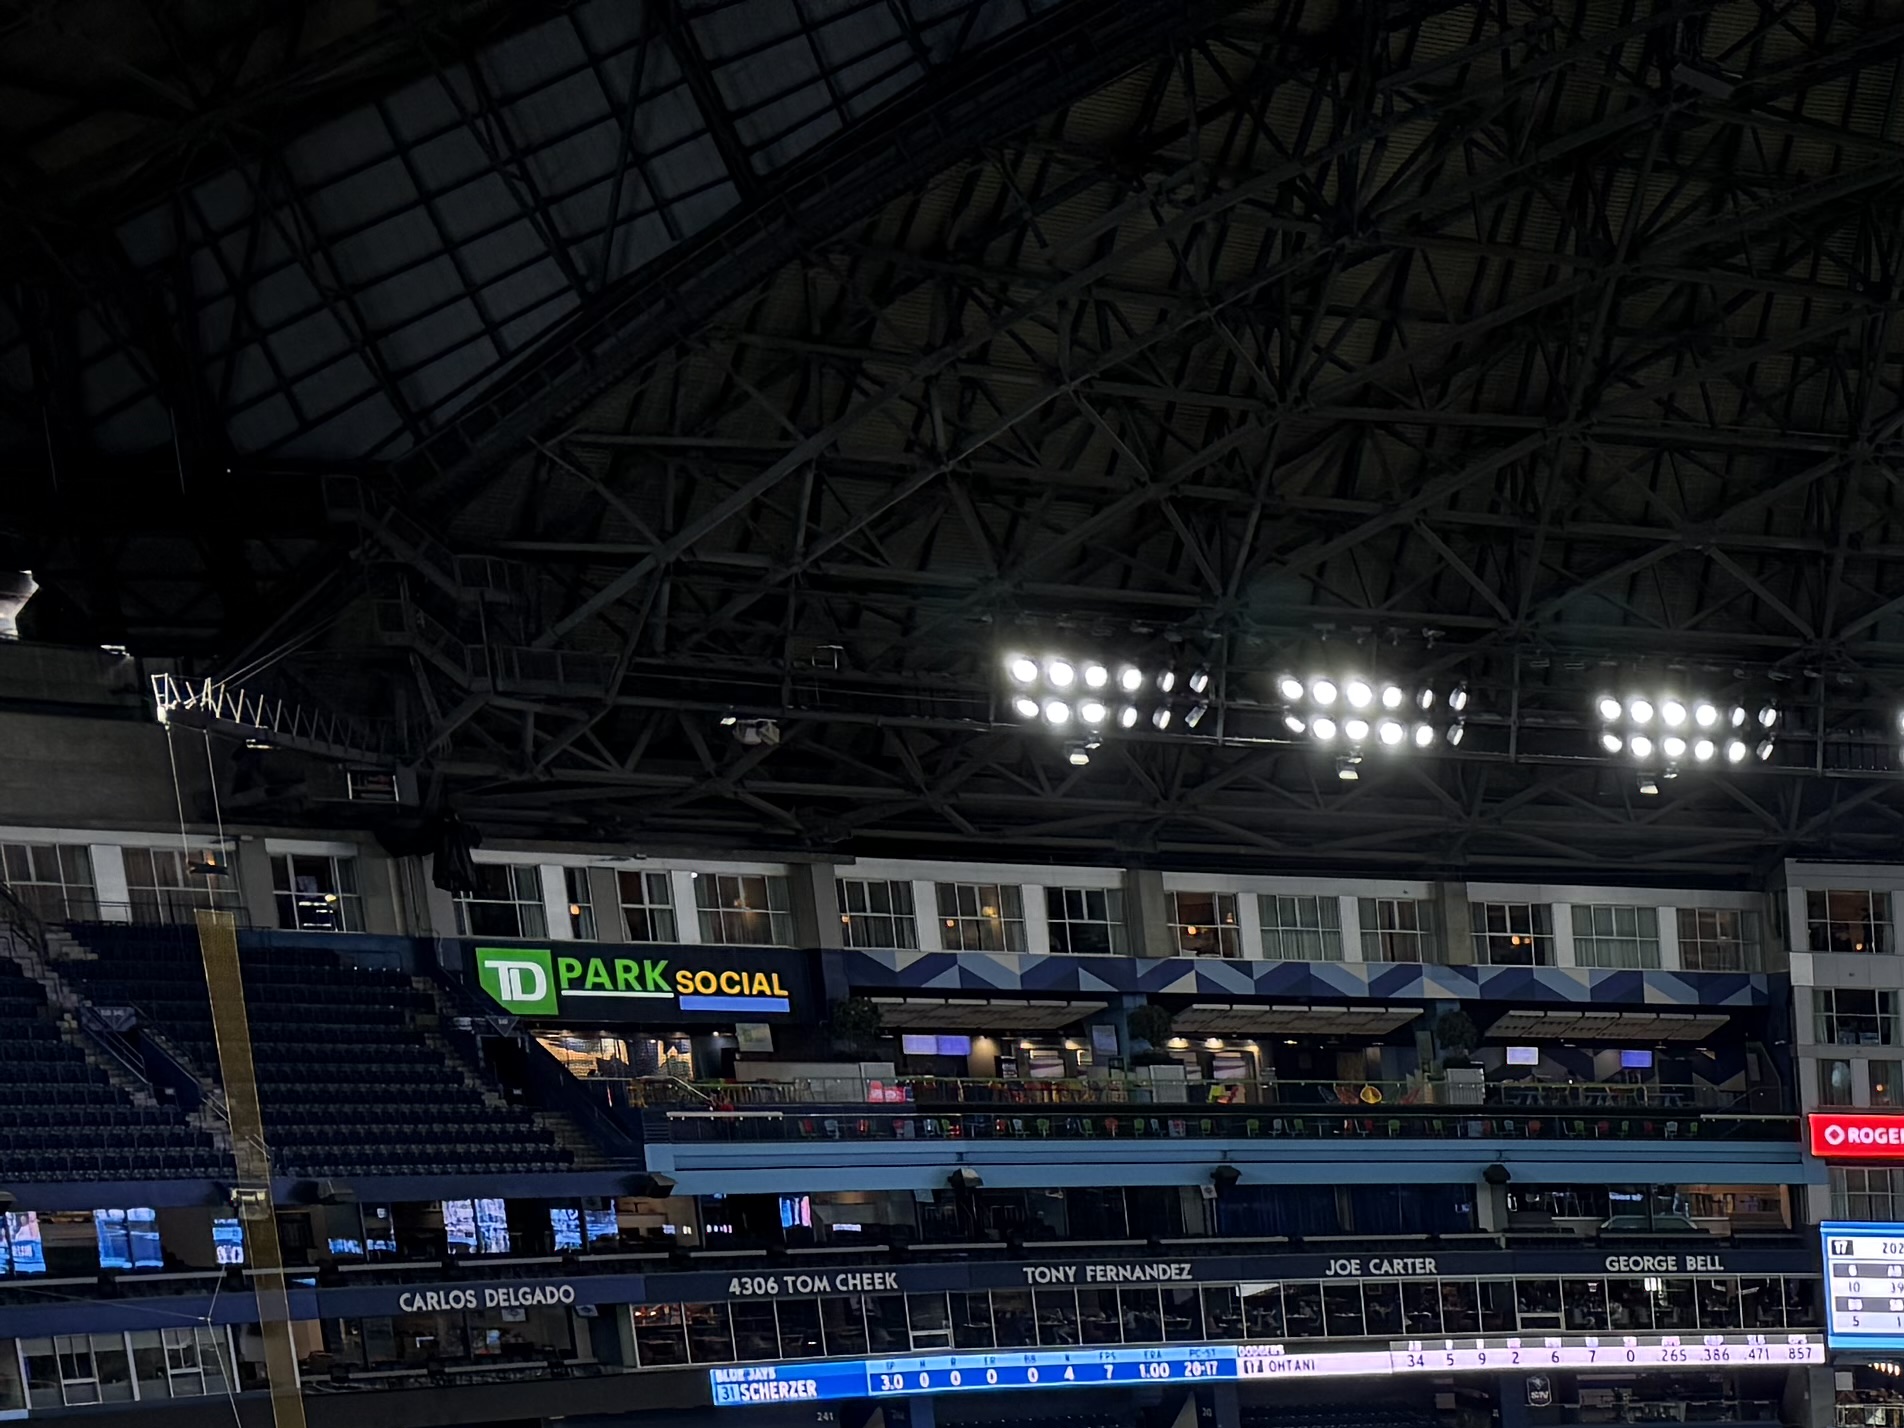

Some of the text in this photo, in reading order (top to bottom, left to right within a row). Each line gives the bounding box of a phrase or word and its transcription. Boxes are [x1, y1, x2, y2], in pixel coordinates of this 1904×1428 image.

[485, 958, 788, 1000] TD PARK SOCIAL
[1326, 1257, 1437, 1276] JOE CARTER
[1606, 1255, 1724, 1272] GEORGE BELL
[729, 1272, 898, 1295] 4306 TOM CHEEK
[1023, 1264, 1192, 1285] TONY FERNANDEZ
[400, 1285, 575, 1312] CARLOS DELGADO
[740, 1379, 817, 1400] SCHERZER
